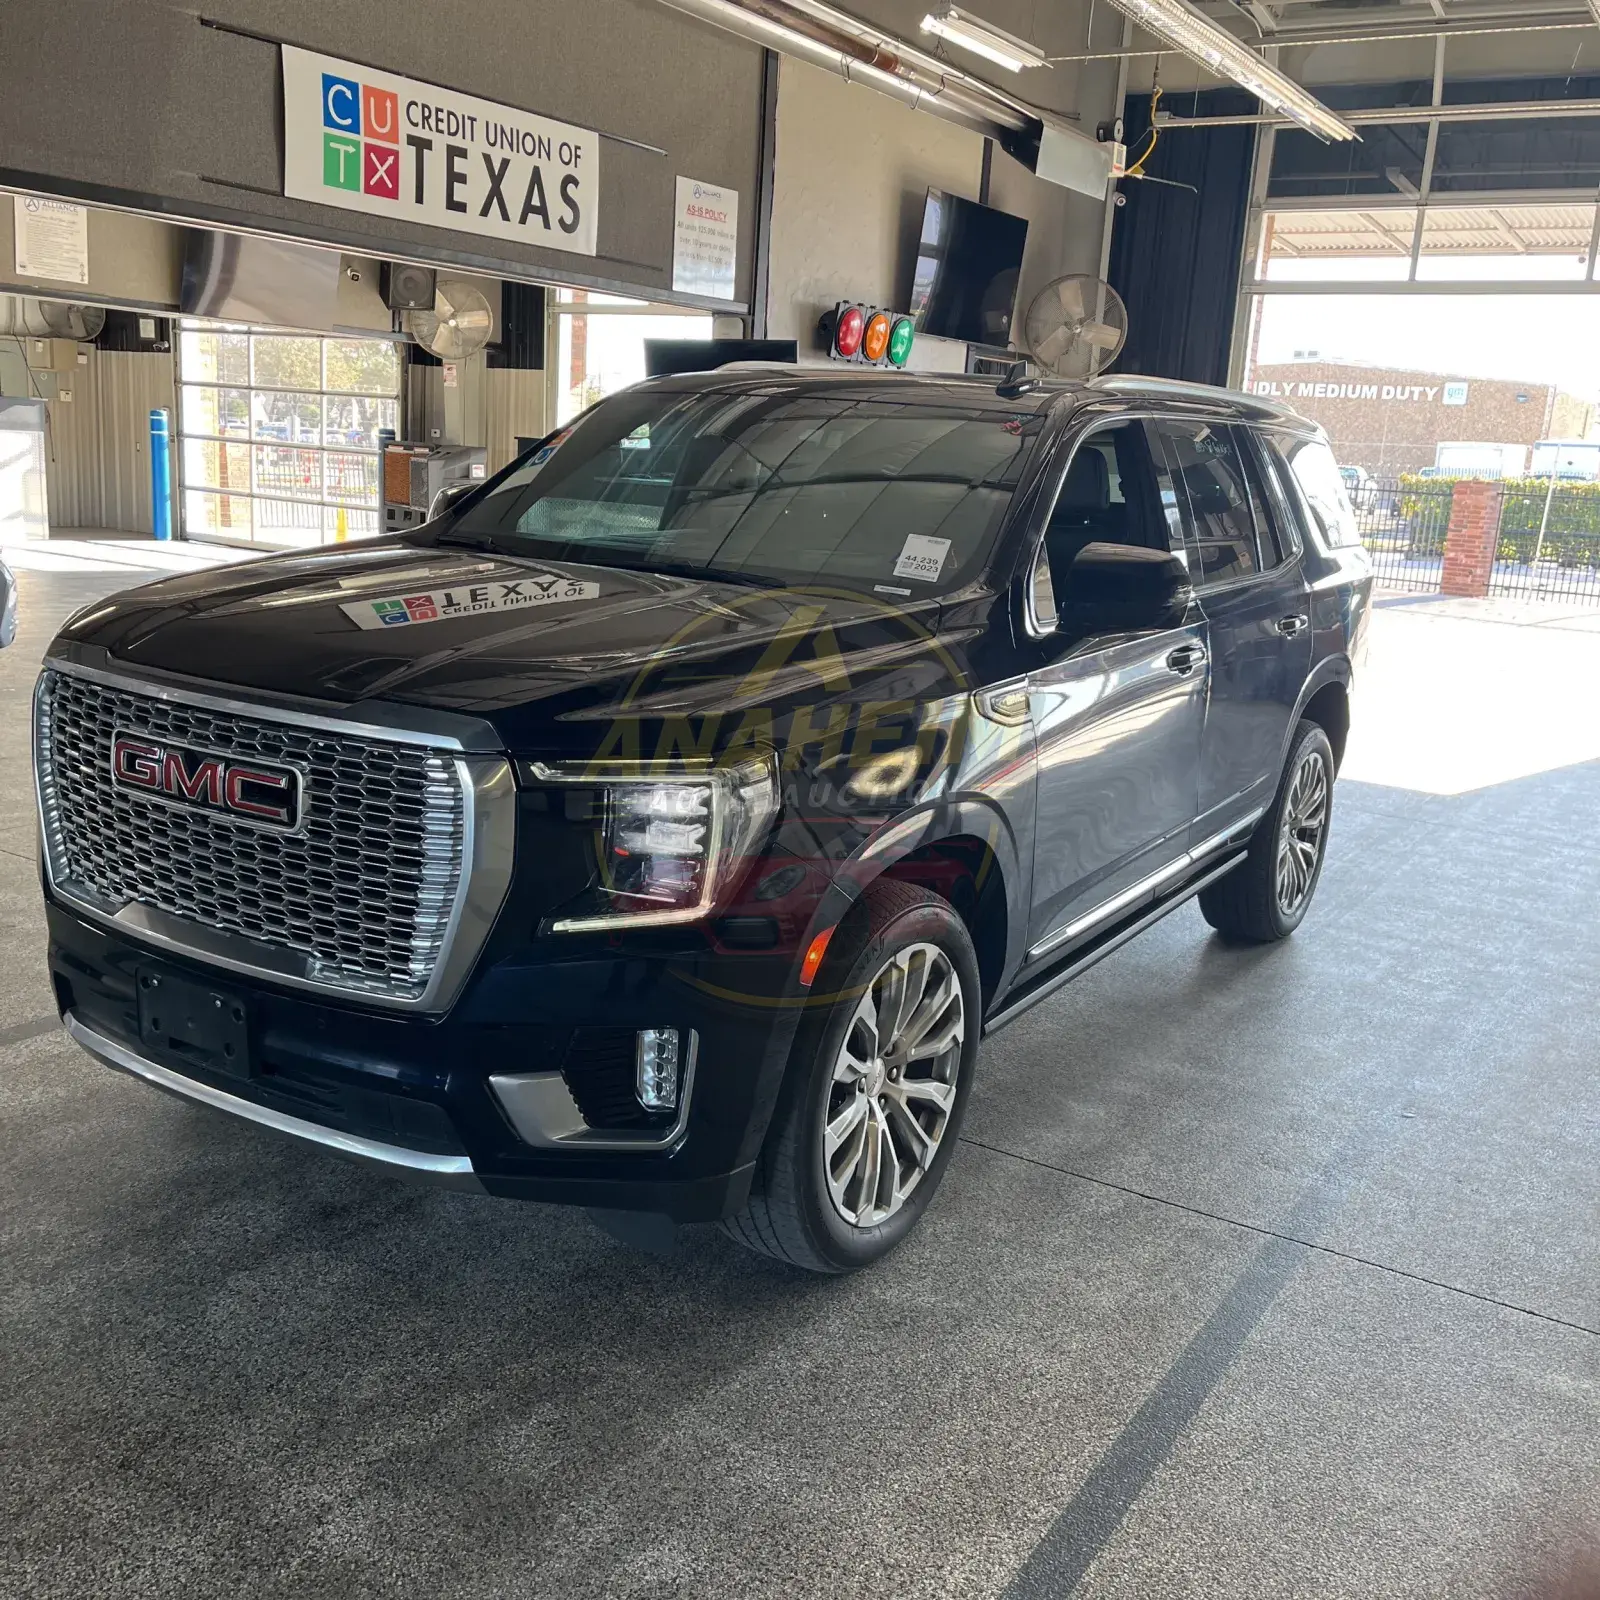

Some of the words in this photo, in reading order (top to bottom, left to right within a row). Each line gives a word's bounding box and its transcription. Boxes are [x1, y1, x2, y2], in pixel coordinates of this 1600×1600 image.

[406, 100, 478, 142] CREDIT
[486, 122, 551, 162] UNION
[559, 141, 582, 168] OF
[407, 133, 581, 234] TEXAS
[687, 204, 704, 216] AS-IS
[705, 208, 728, 221] POLICY
[1298, 384, 1378, 399] MEDIUM
[1382, 385, 1439, 401] DUTY
[914, 564, 939, 573] 2023
[114, 737, 290, 823] GMC
